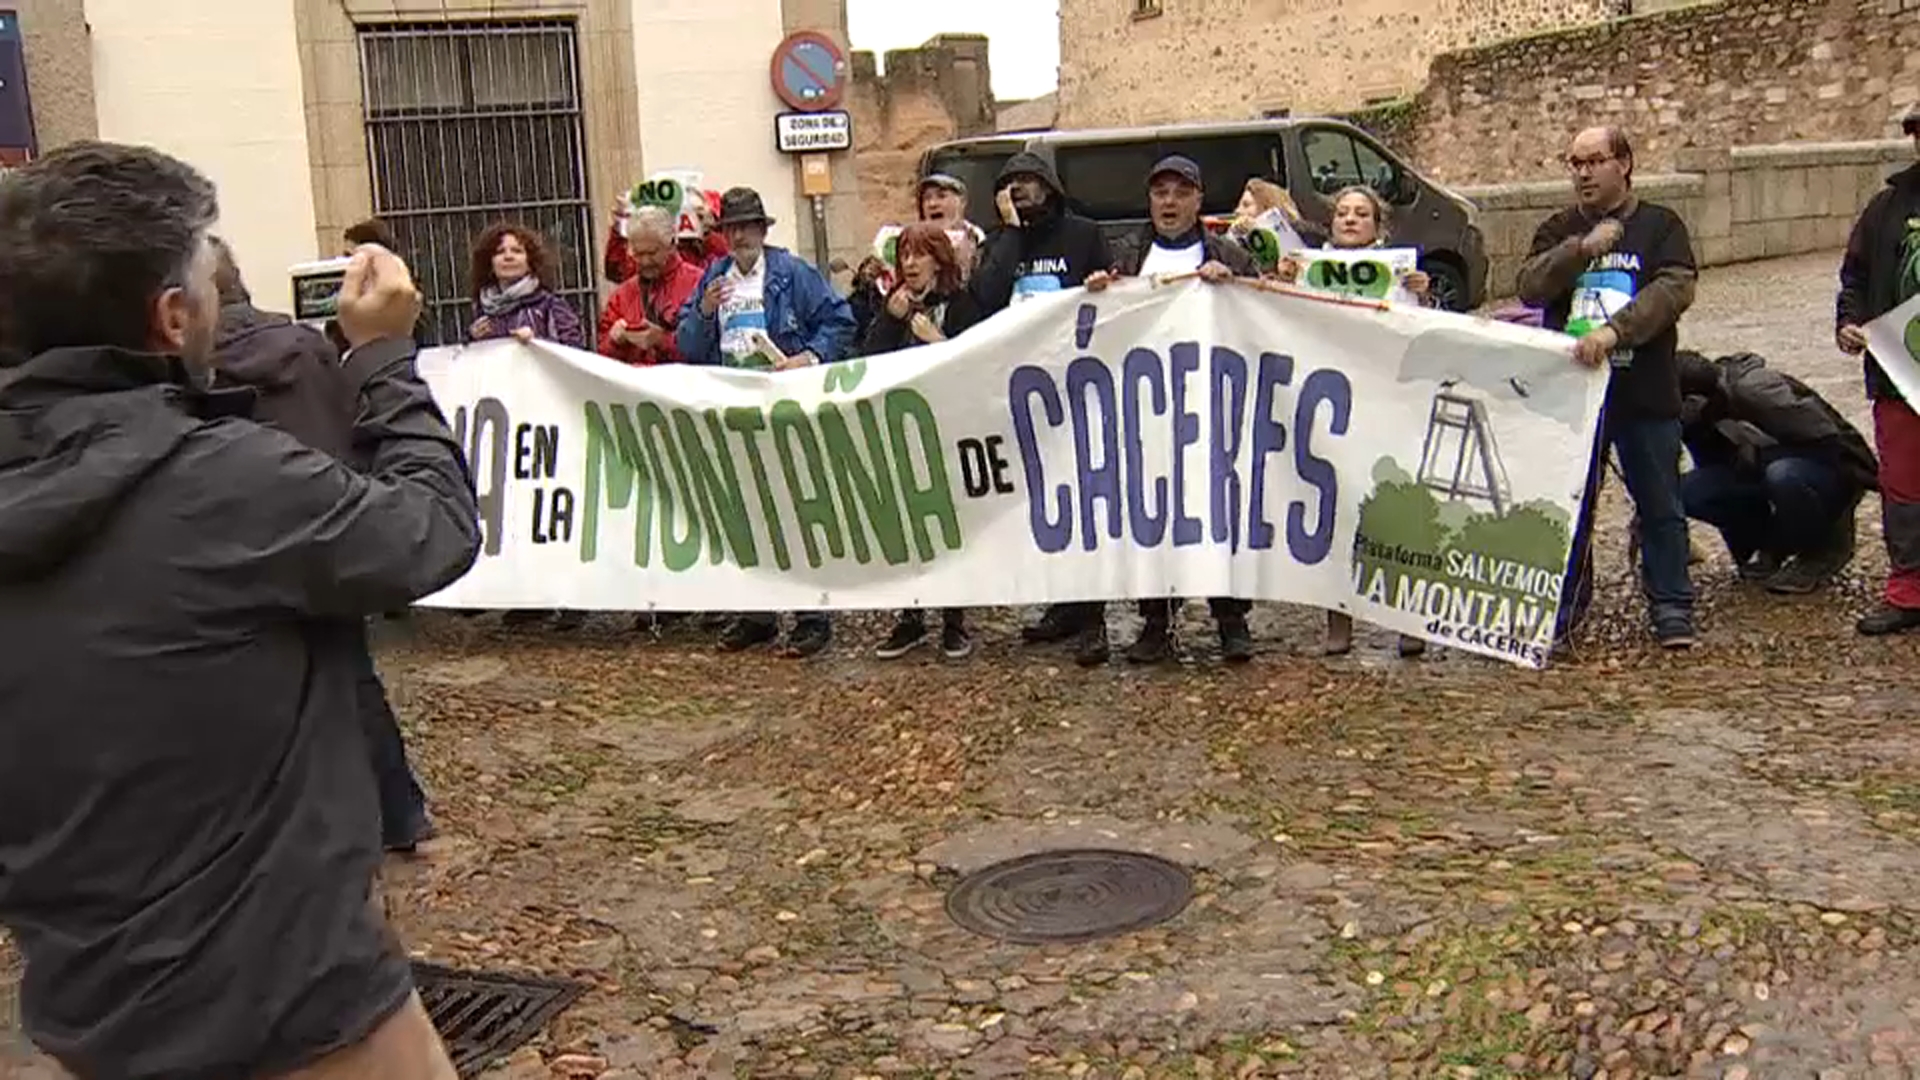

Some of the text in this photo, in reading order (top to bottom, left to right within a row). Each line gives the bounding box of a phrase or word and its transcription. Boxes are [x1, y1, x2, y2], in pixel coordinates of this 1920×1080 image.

[789, 118, 820, 130] ZONA
[784, 133, 845, 147] SEGURIDAD
[638, 179, 675, 202] NO
[1031, 256, 1068, 274] MINA
[1600, 252, 1641, 271] MINA
[1320, 260, 1379, 287] NO
[455, 303, 1353, 573] A EN MONTAÑA DE CÁCERES
[531, 486, 575, 544] LA
[1446, 548, 1564, 602] SALVEMOS
[1354, 560, 1556, 646] LA MONTAÑA
[1426, 618, 1454, 639] de
